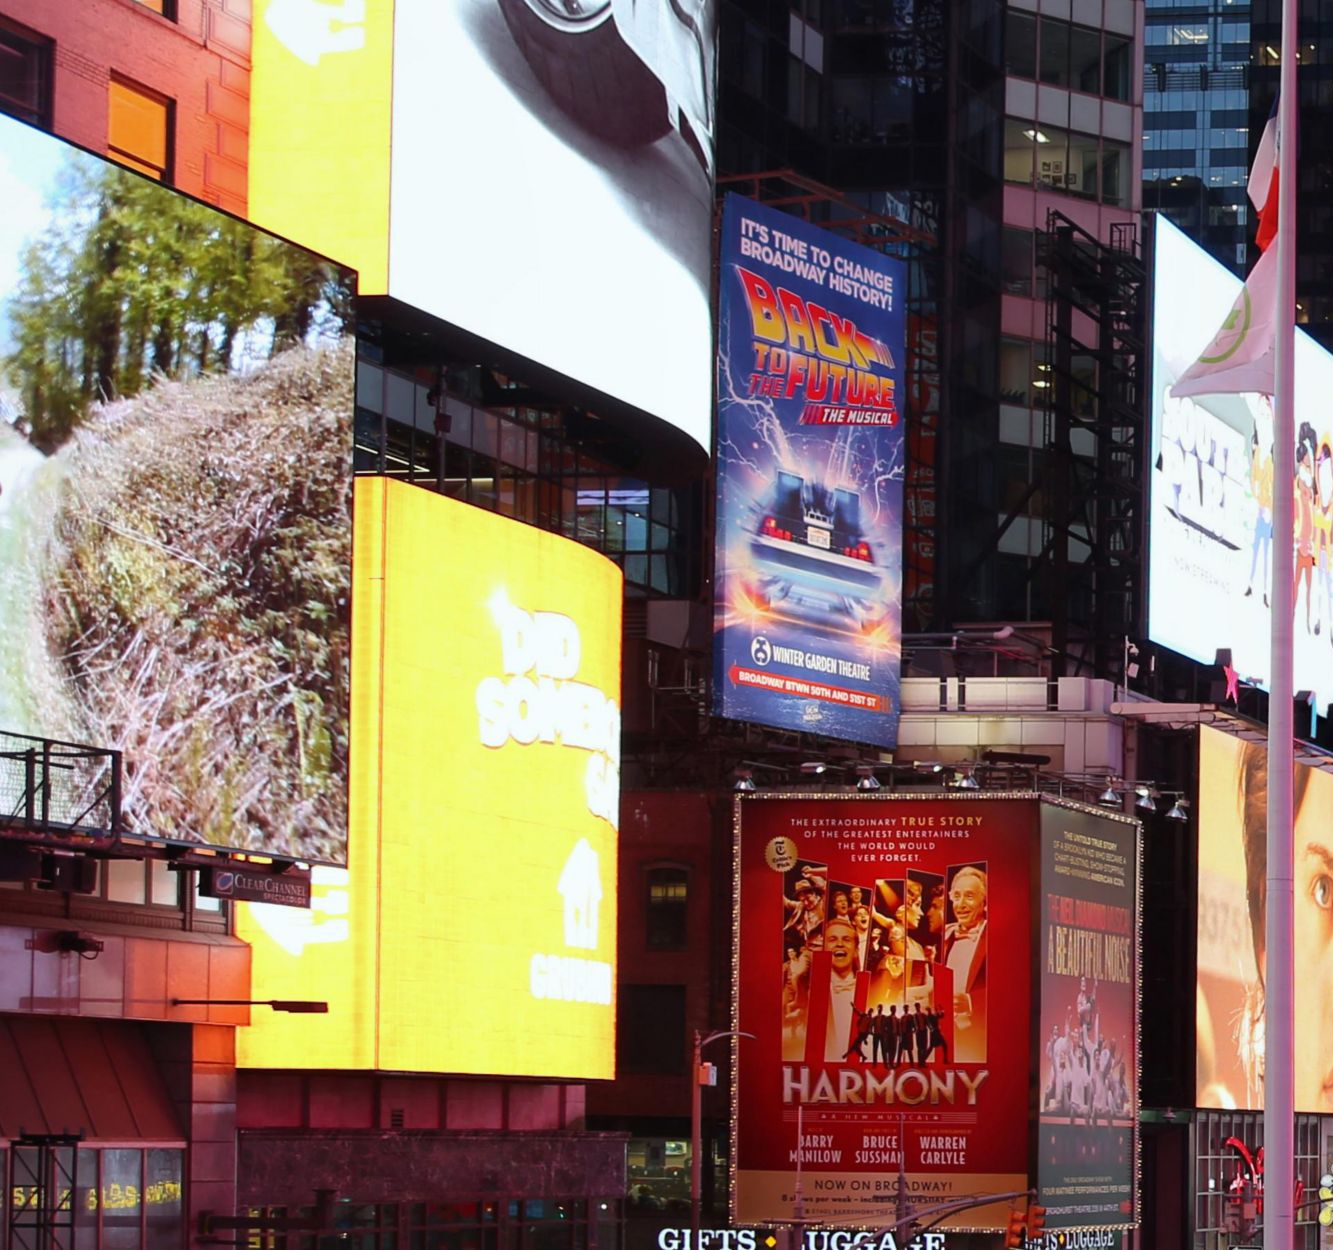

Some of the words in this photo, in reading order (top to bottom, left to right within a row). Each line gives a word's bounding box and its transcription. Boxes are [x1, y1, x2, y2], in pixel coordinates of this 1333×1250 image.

[741, 218, 769, 242] IT'S
[772, 230, 807, 259] TIME
[811, 244, 830, 268] TO
[834, 256, 893, 292] CHANGE
[741, 238, 826, 284] BROADWAY
[829, 273, 892, 311] HISTORY!
[736, 266, 895, 369] BACK
[748, 373, 784, 398] THE
[753, 341, 787, 374] TO
[785, 351, 895, 410] FUTURE
[822, 408, 845, 423] THE
[847, 409, 893, 425] MUSICAL
[772, 645, 804, 666] WINTER
[805, 651, 837, 674] GARDEN
[838, 657, 871, 681] THEATRE
[739, 670, 784, 692] BROADWAY
[785, 679, 809, 694] BTWN
[811, 684, 831, 700] 50TH
[832, 689, 848, 701] AND
[867, 697, 876, 708] ST
[791, 818, 809, 826] THE
[812, 818, 896, 826] EXTRAORDINARY
[901, 817, 935, 826] TRUE
[940, 817, 983, 826] STORY
[804, 830, 817, 838] OF
[821, 830, 839, 838] THE
[843, 830, 892, 838] GREATEST
[896, 830, 970, 838] ENTERTAINERS
[1091, 836, 1102, 847] TRUE
[1103, 839, 1117, 850] STORY
[838, 842, 855, 850] THE
[860, 842, 895, 850] WORLD
[899, 842, 936, 850] WOULD
[851, 854, 876, 862] EVER
[880, 854, 922, 862] FORGET.
[1047, 925, 1055, 974] A
[1056, 926, 1103, 980] BEAUTIFUL
[1104, 933, 1131, 984] NOISE
[782, 1066, 989, 1105] HARMONY
[800, 1135, 834, 1148] BARRY
[863, 1136, 898, 1148] BRUCE
[919, 1136, 966, 1149] WARREN
[789, 1150, 842, 1164] MANILOW
[855, 1151, 904, 1164] SUSSMAN
[920, 1151, 966, 1165] CARLYLE
[814, 1180, 847, 1191] NOW
[851, 1180, 871, 1191] ON
[658, 1228, 757, 1250] GIFTS
[1066, 1231, 1114, 1250] LUGGAGE
